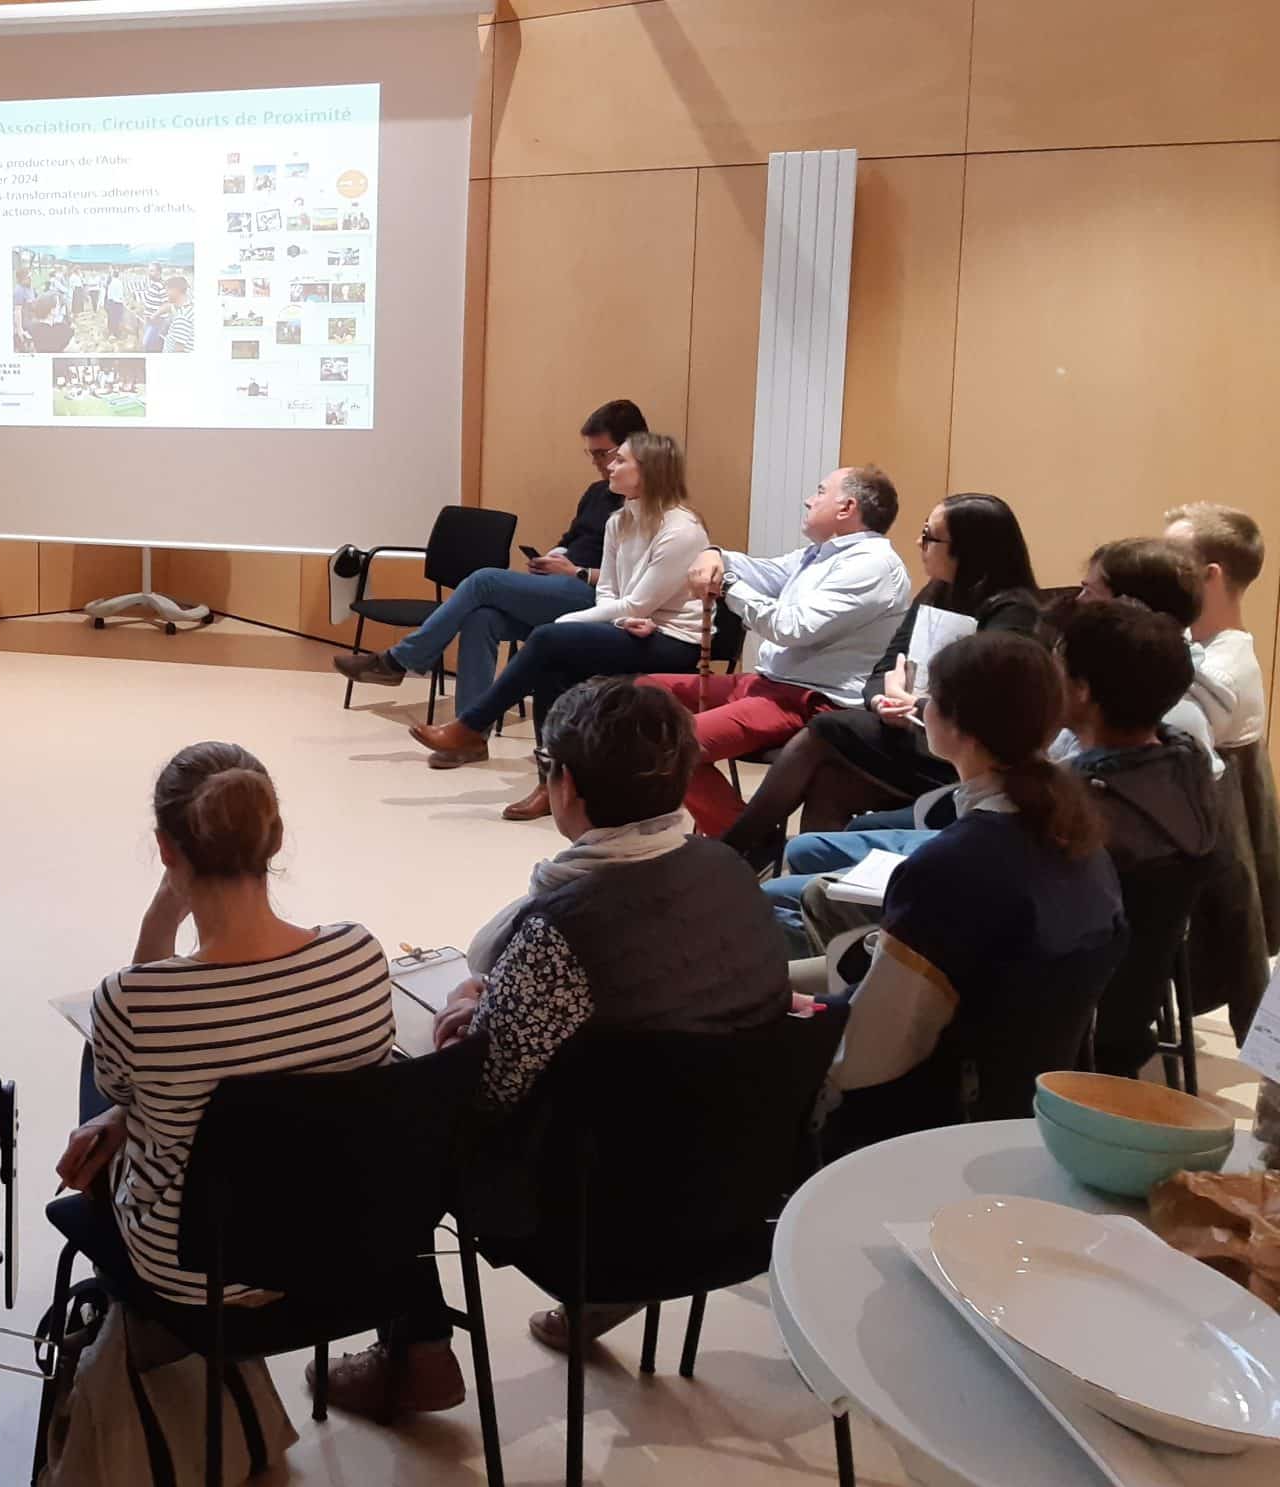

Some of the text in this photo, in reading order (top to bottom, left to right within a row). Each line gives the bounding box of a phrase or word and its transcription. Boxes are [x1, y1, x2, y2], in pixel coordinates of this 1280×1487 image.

[103, 114, 167, 131] Circuits
[172, 112, 231, 129] Courts
[235, 110, 258, 127] de
[263, 104, 353, 125] Proximité
[6, 157, 76, 170] producteurs
[78, 155, 94, 166] de
[11, 173, 39, 185] 2024
[48, 204, 80, 216] outils
[83, 204, 141, 215] communs
